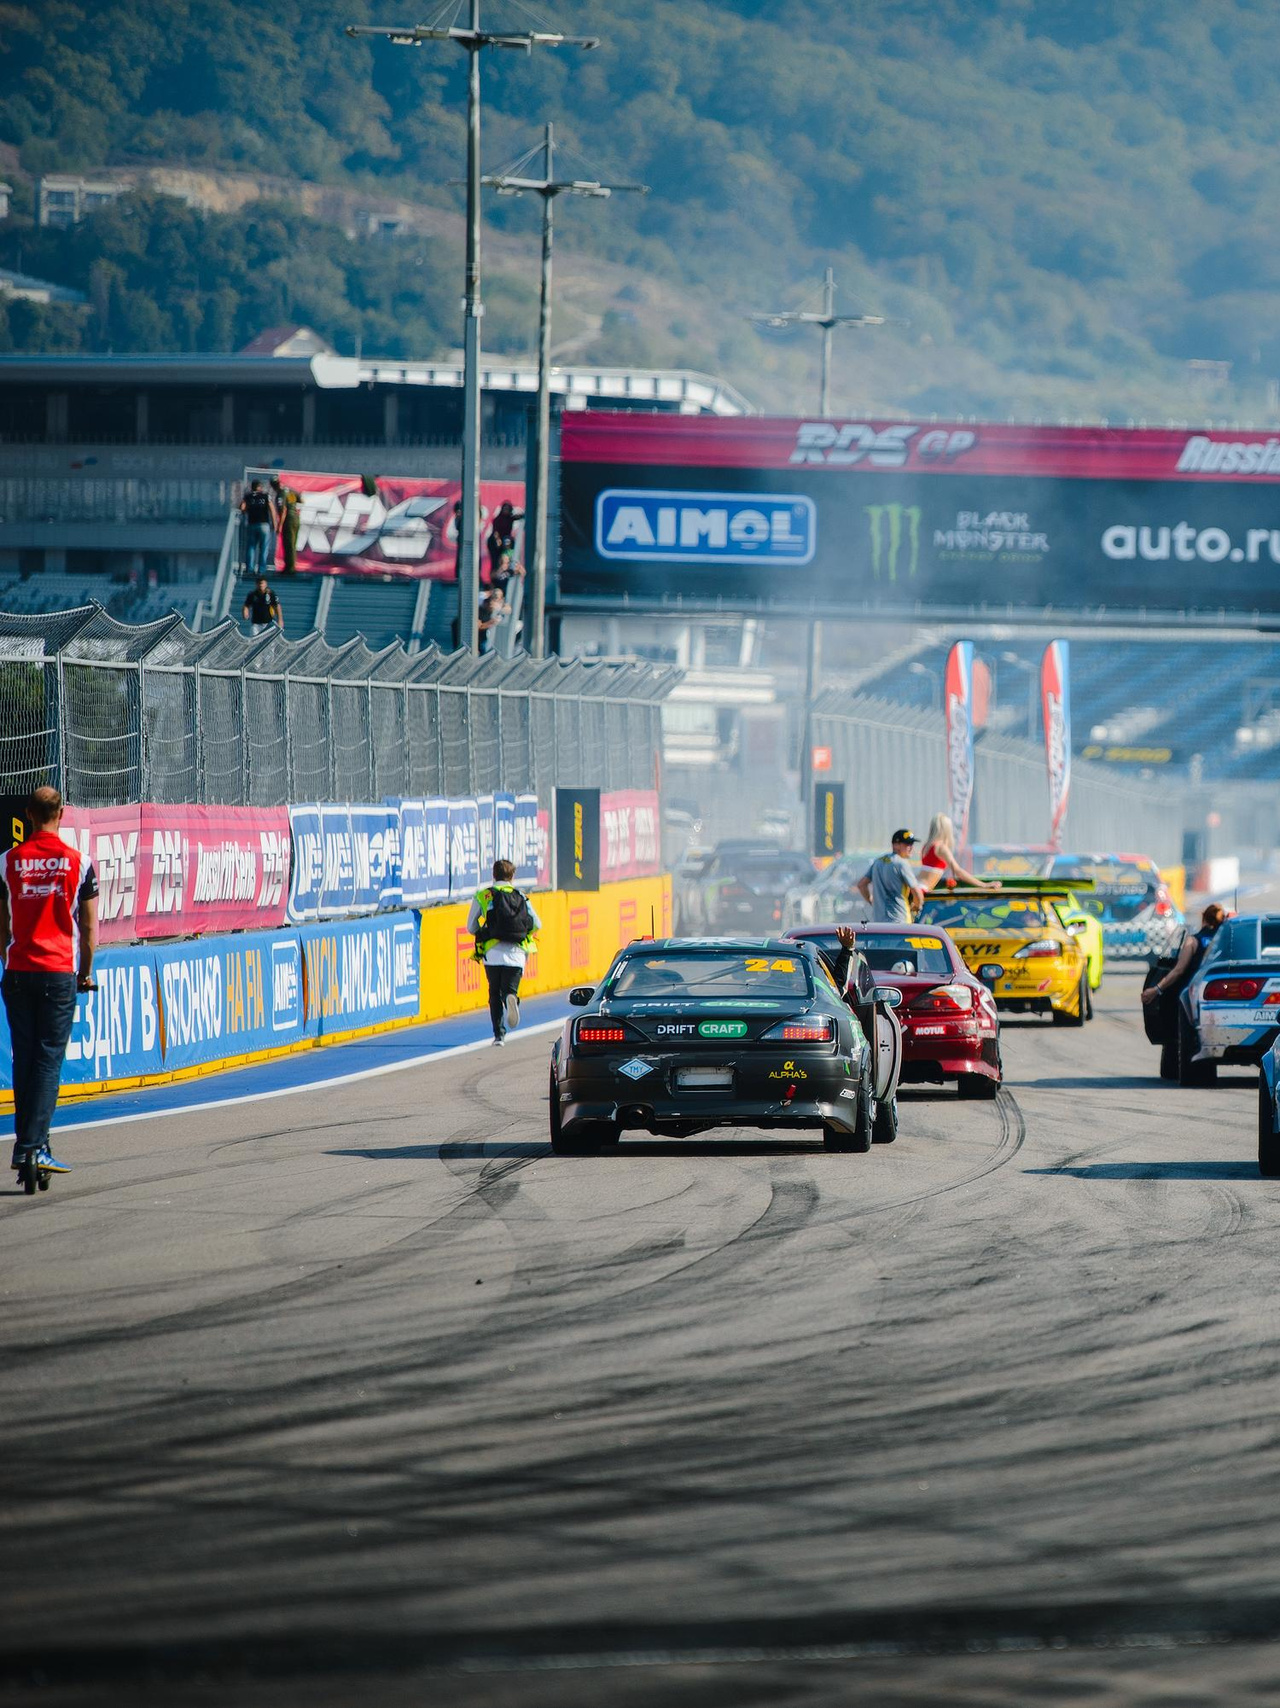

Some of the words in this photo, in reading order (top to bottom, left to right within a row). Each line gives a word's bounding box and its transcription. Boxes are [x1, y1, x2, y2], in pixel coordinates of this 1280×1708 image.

[790, 423, 918, 466] RDS
[917, 430, 975, 458] GP
[296, 491, 448, 558] RDS
[606, 505, 804, 550] AIMOL
[957, 511, 1030, 532] BLACK
[933, 529, 1051, 552] MONSTER
[14, 857, 71, 872] LUKOIL
[904, 937, 943, 950] 19
[744, 959, 796, 974] 24
[139, 965, 156, 1052] В
[656, 1023, 696, 1035] DRIFT
[700, 1023, 745, 1034] CRAFT
[915, 1027, 945, 1036] MOTUL
[768, 1069, 808, 1080] ALPHA'S
